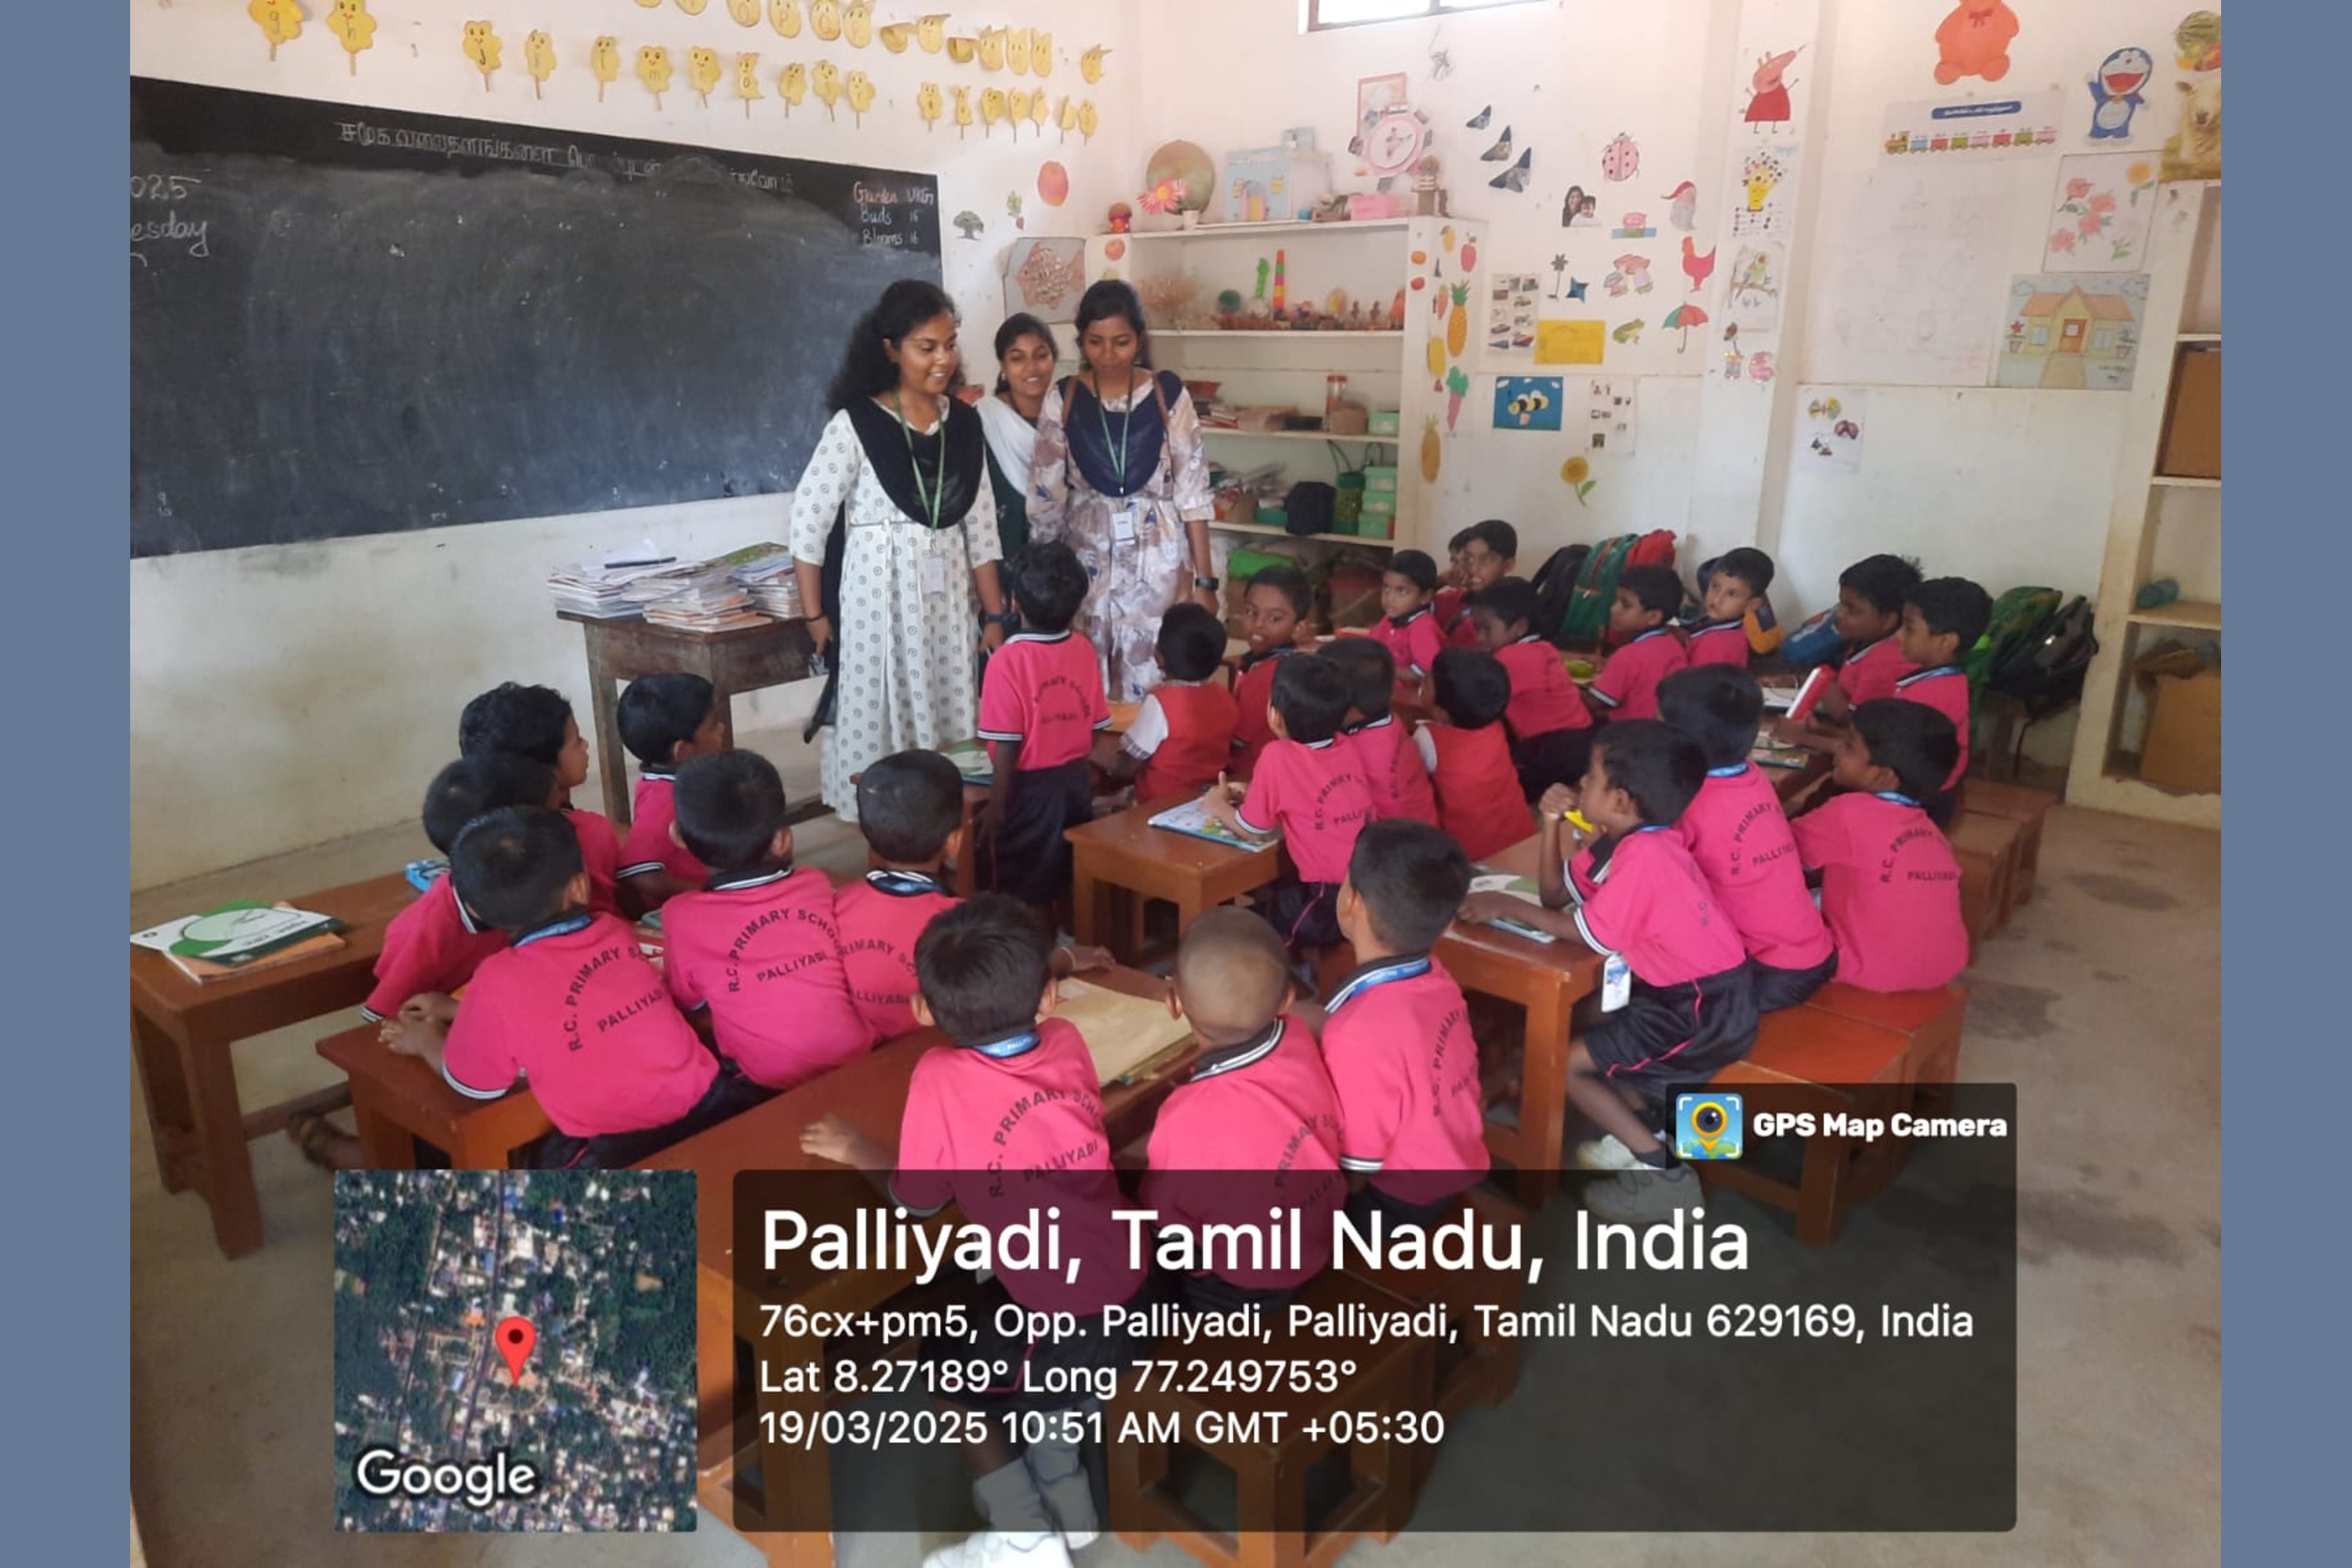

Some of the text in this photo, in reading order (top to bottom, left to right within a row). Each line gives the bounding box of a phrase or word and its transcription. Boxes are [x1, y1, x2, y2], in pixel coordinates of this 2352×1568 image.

[861, 203, 892, 226] Buds
[862, 226, 903, 247] Blooms
[733, 908, 790, 961] PRIMARY
[564, 946, 621, 1007] PRIMARY
[993, 1087, 1067, 1145] PRIMARY
